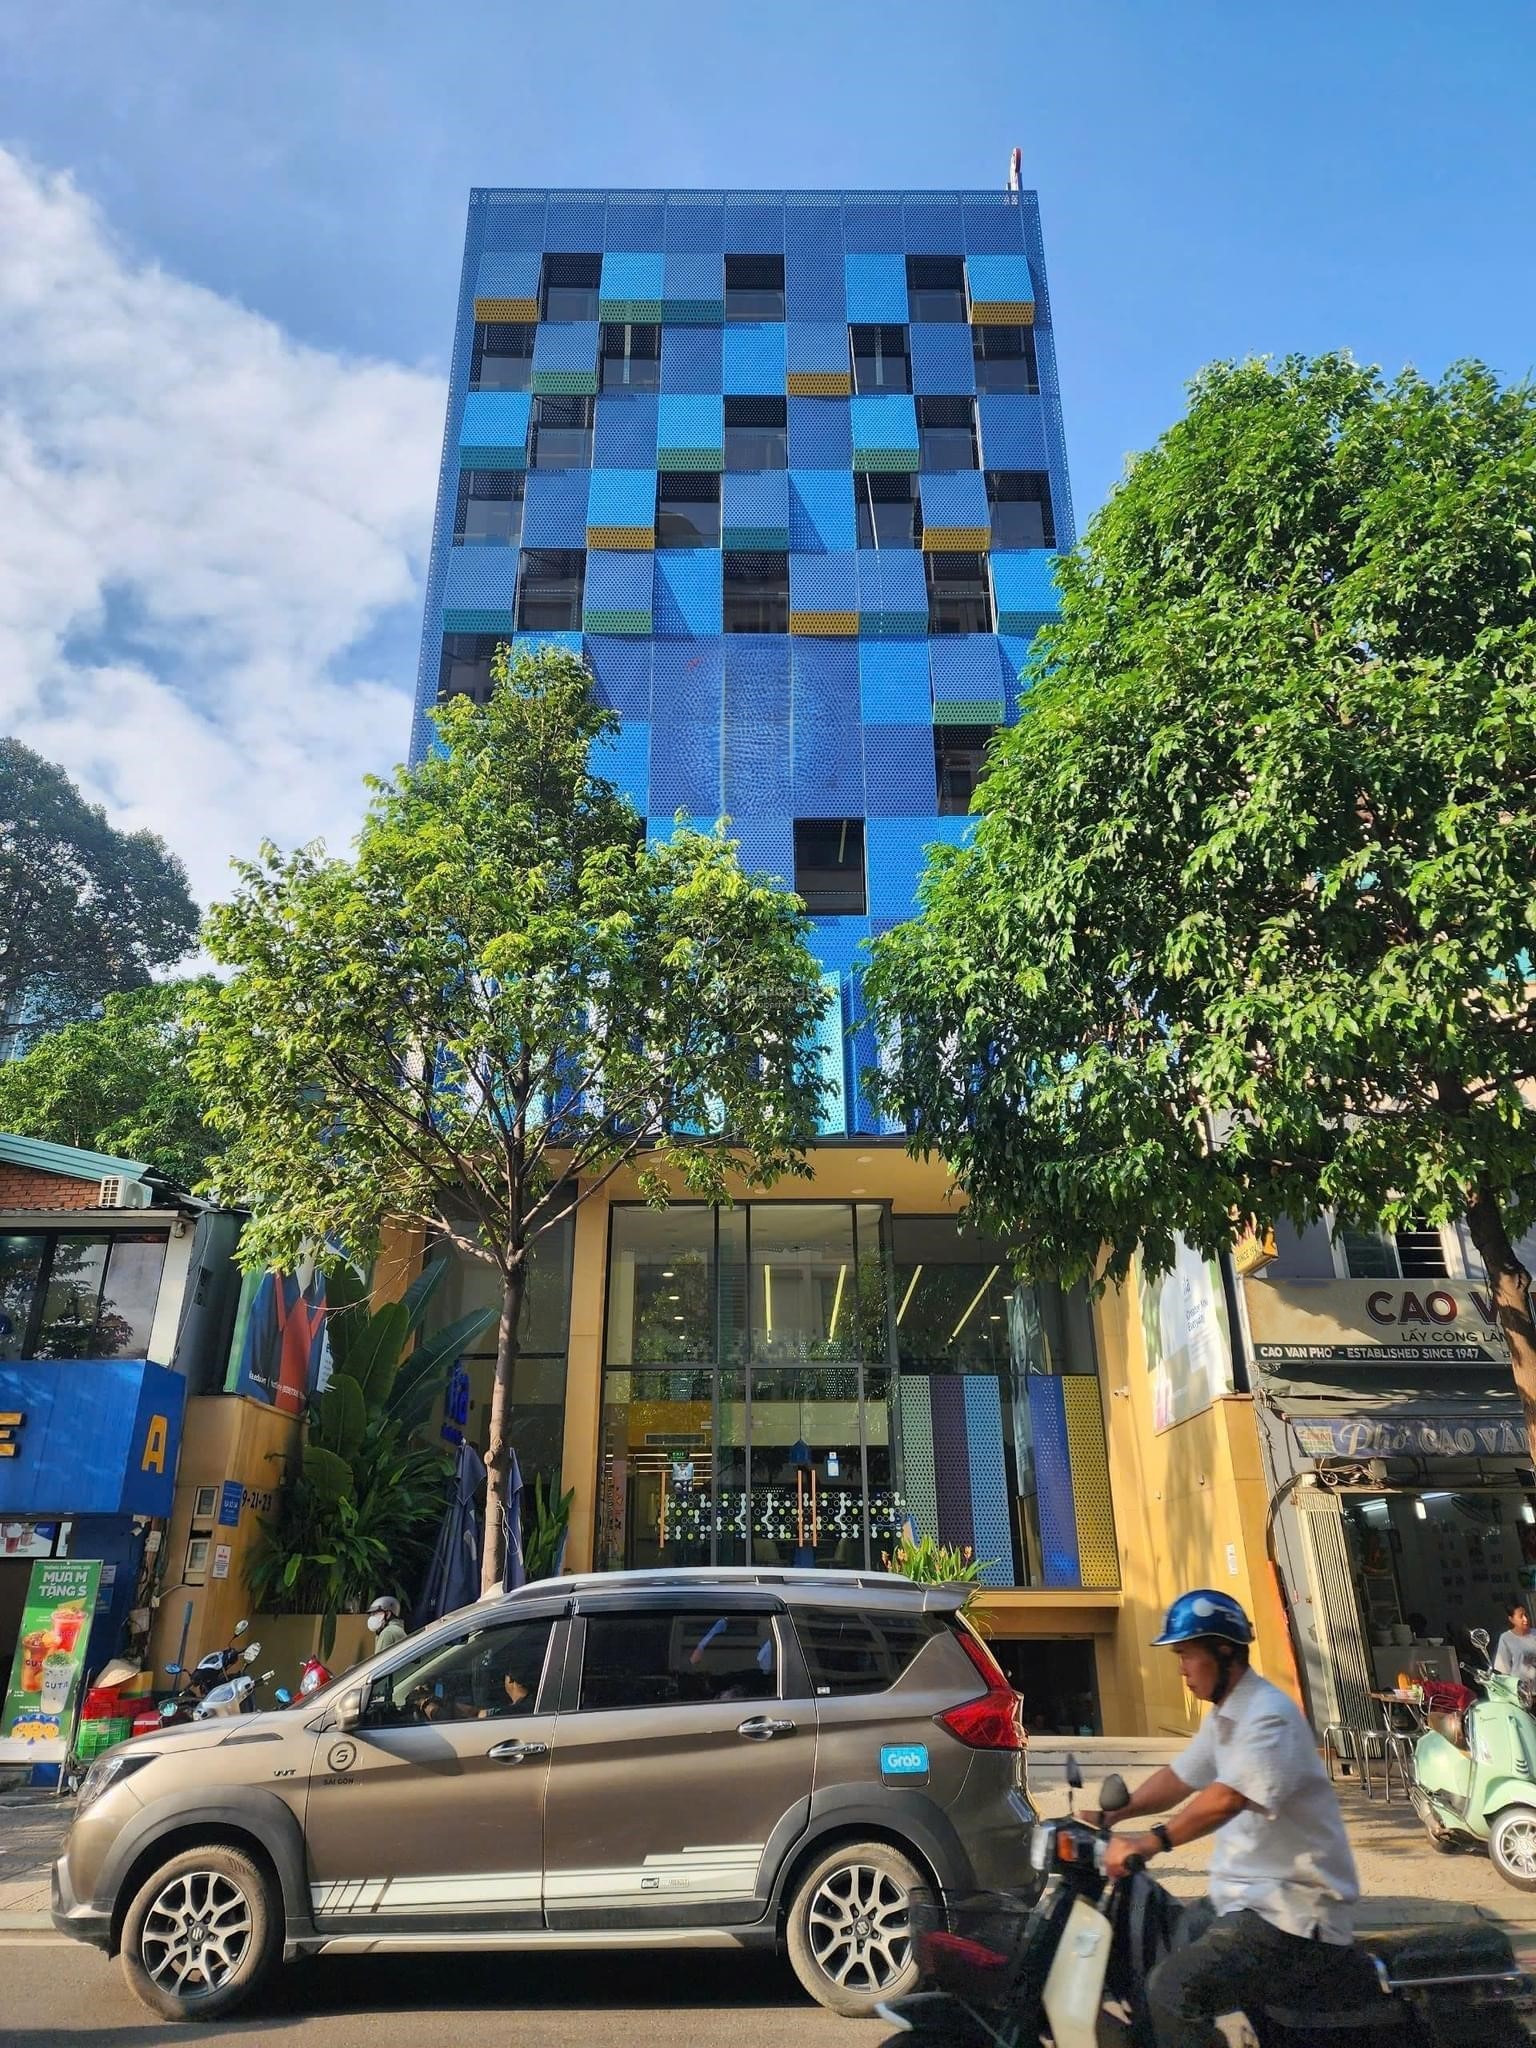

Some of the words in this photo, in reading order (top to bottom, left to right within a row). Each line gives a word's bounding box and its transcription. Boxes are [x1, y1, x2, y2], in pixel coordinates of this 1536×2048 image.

[1366, 1291, 1458, 1325] CAO
[1260, 1346, 1282, 1358] CAO
[1347, 1347, 1420, 1359] ESTABLISHED
[1422, 1348, 1454, 1359] SINCE
[1456, 1348, 1479, 1359] 1947
[141, 1414, 168, 1474] A
[43, 1571, 73, 1582] MUA
[75, 1571, 88, 1582] M
[39, 1583, 76, 1599] TẶNG
[77, 1585, 88, 1597] S
[887, 1752, 921, 1768] Grab
